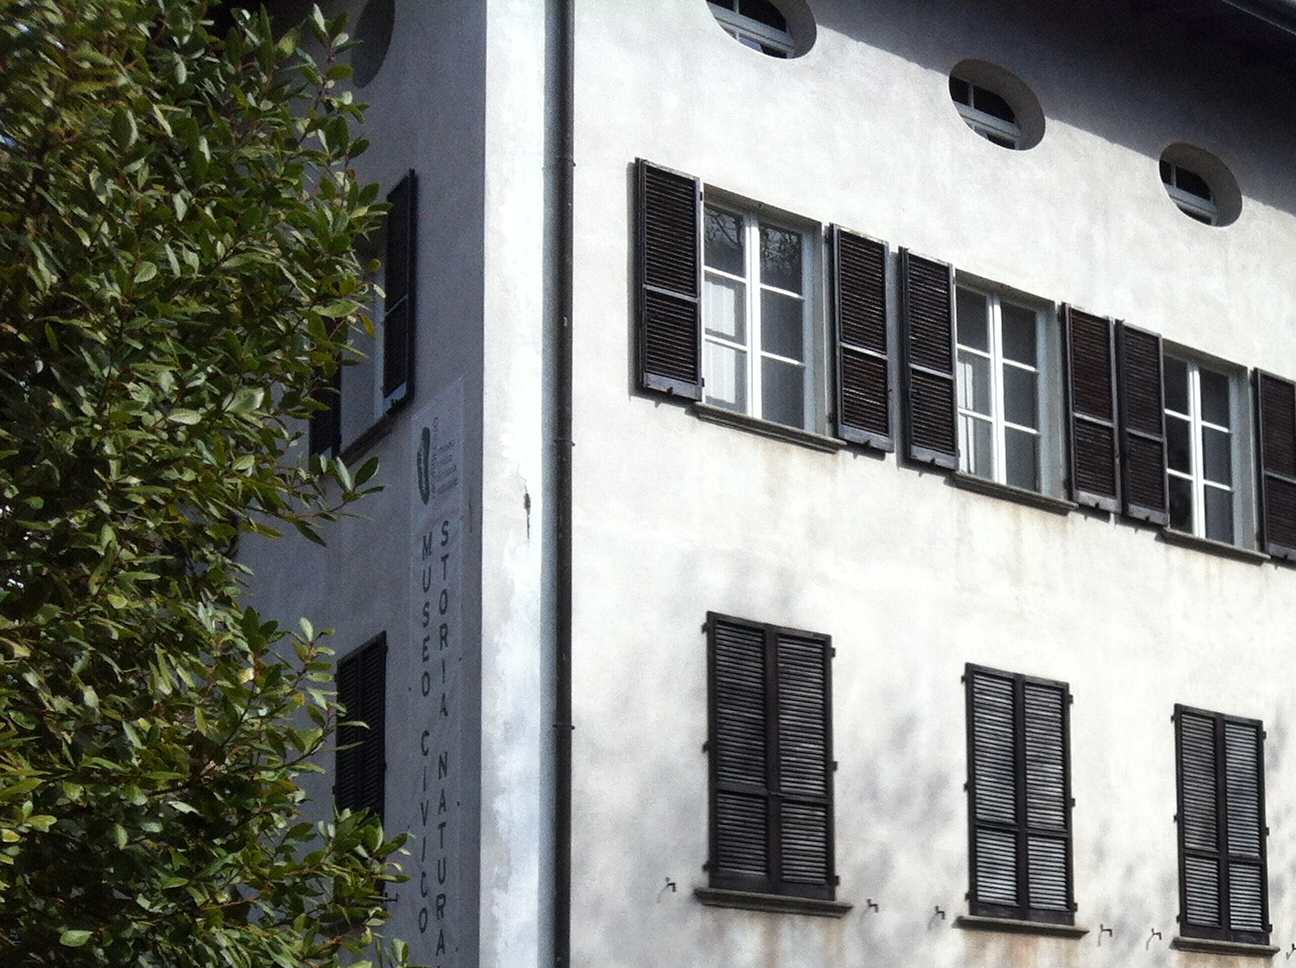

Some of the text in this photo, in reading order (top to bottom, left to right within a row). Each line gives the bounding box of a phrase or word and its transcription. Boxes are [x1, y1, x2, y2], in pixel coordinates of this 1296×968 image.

[421, 531, 433, 697] MUSEO
[438, 520, 450, 718] STORIA
[419, 730, 431, 934] CIVICO
